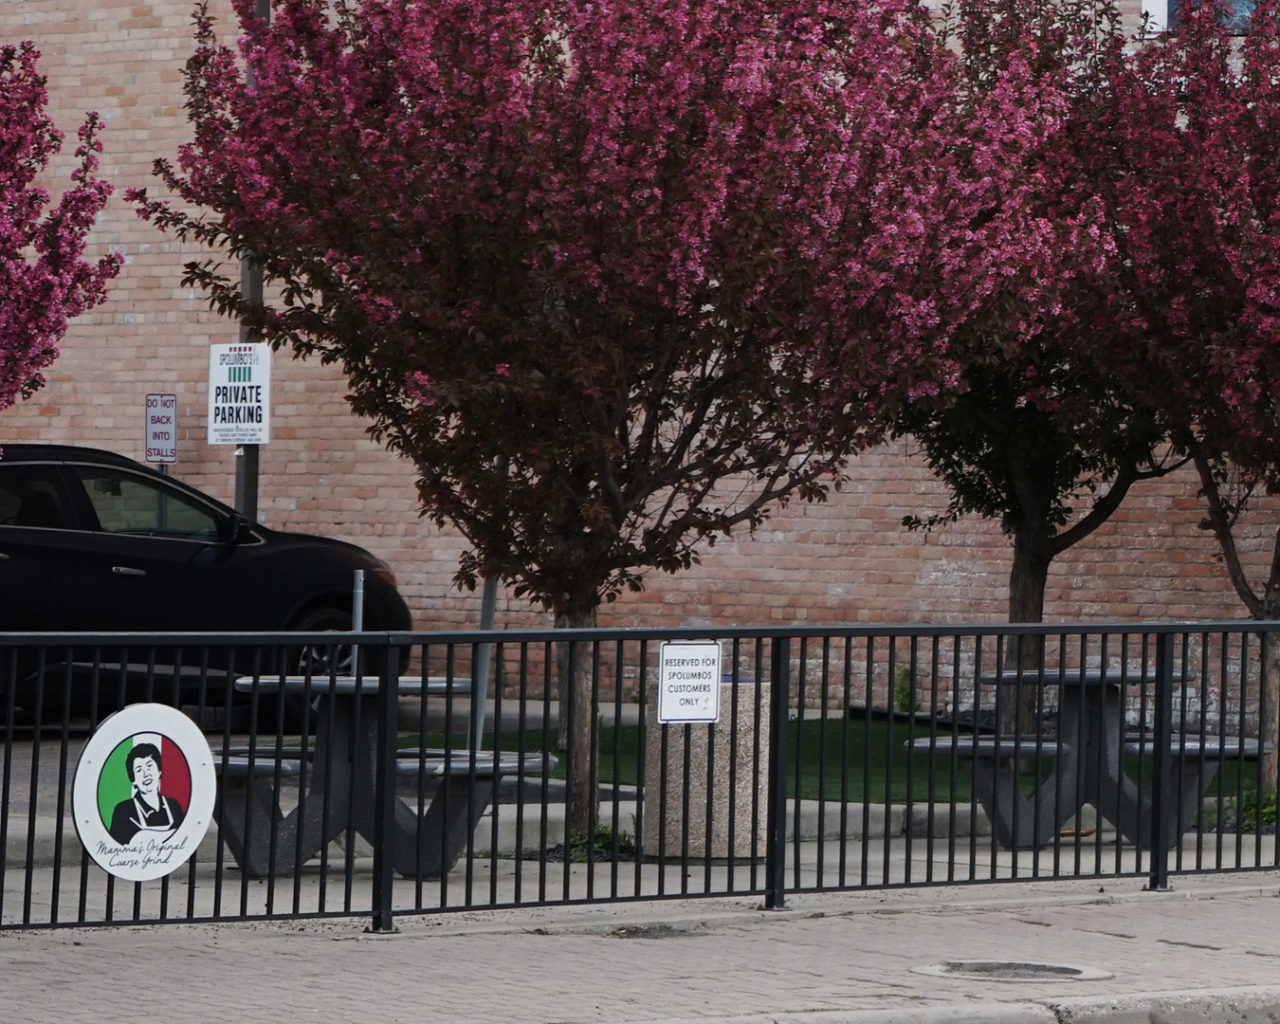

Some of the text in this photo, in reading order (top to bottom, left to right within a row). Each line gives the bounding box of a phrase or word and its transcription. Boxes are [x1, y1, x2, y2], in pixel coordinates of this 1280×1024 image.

[216, 386, 261, 403] PRIVATE
[147, 399, 175, 408] DO NOT
[151, 415, 171, 424] BACK
[214, 406, 262, 424] PARKING
[152, 432, 170, 440] INTO
[147, 448, 176, 457] STALLS
[668, 685, 711, 693] CUSTOMERS
[679, 698, 699, 706] ONLY
[147, 836, 188, 856] Original
[109, 851, 173, 869] Coarse Grind
